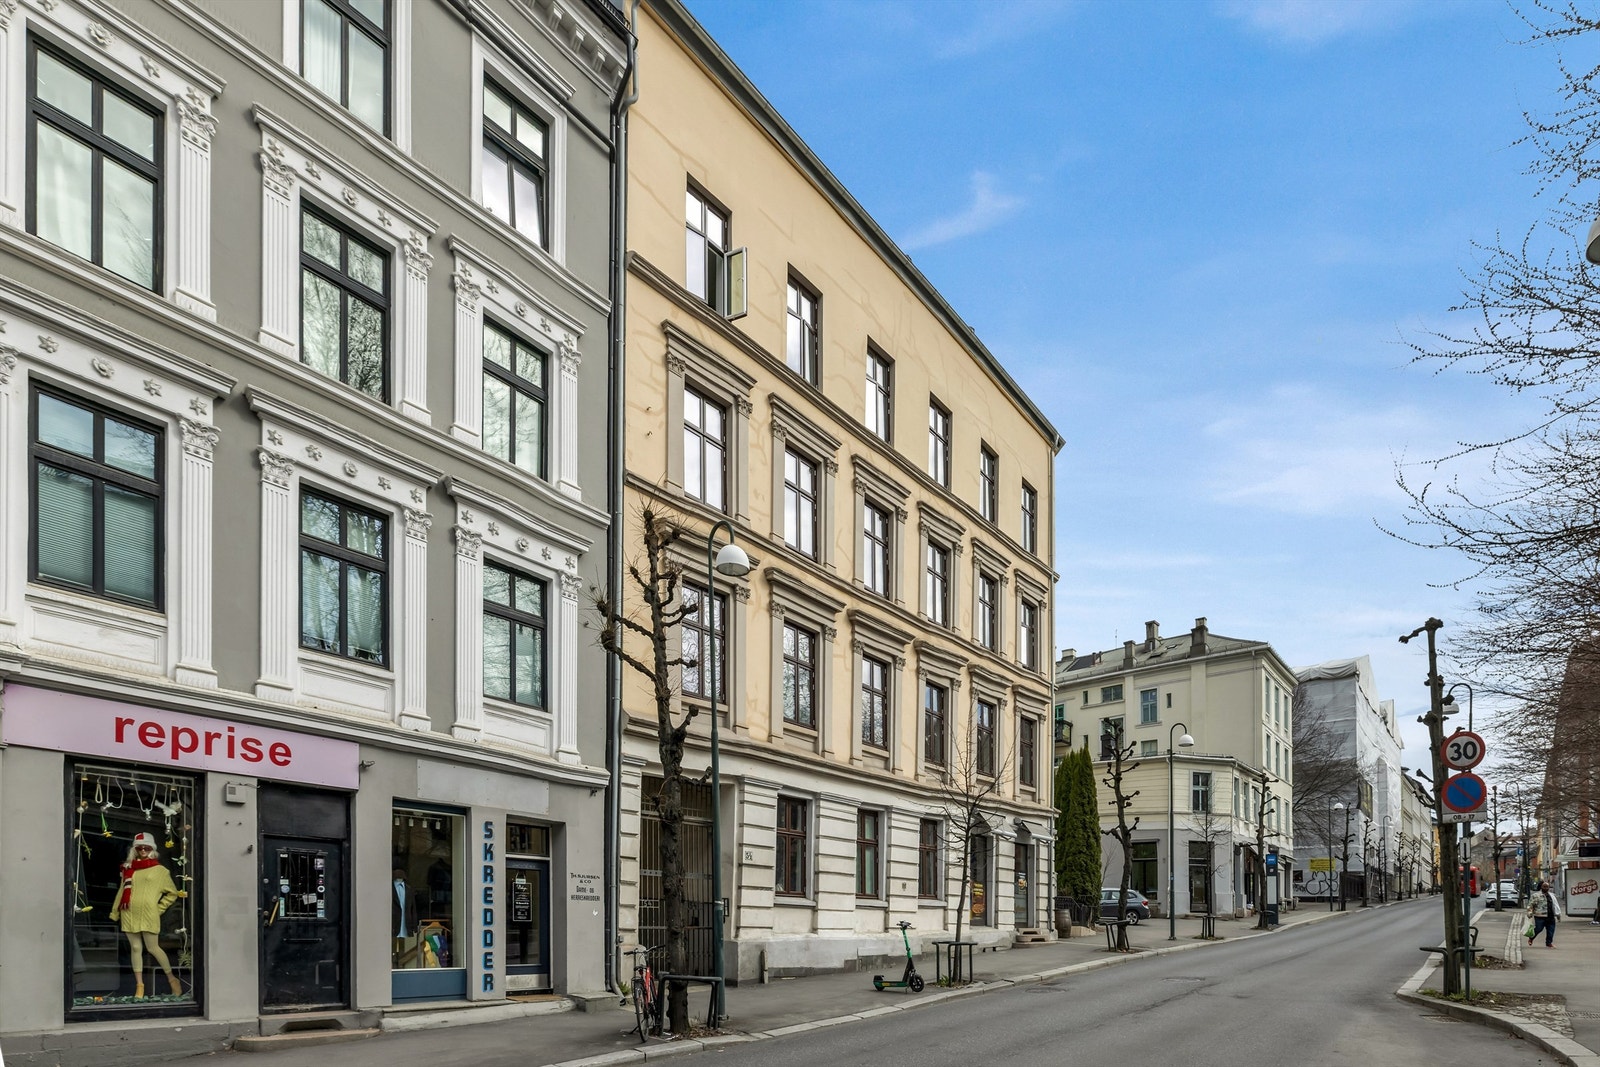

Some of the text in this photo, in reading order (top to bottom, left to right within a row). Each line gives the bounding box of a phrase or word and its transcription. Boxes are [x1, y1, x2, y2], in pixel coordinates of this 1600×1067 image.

[115, 716, 292, 767] reprise
[1450, 741, 1477, 761] 30
[482, 821, 494, 992] SKREDDER
[1571, 884, 1597, 895] Norge
